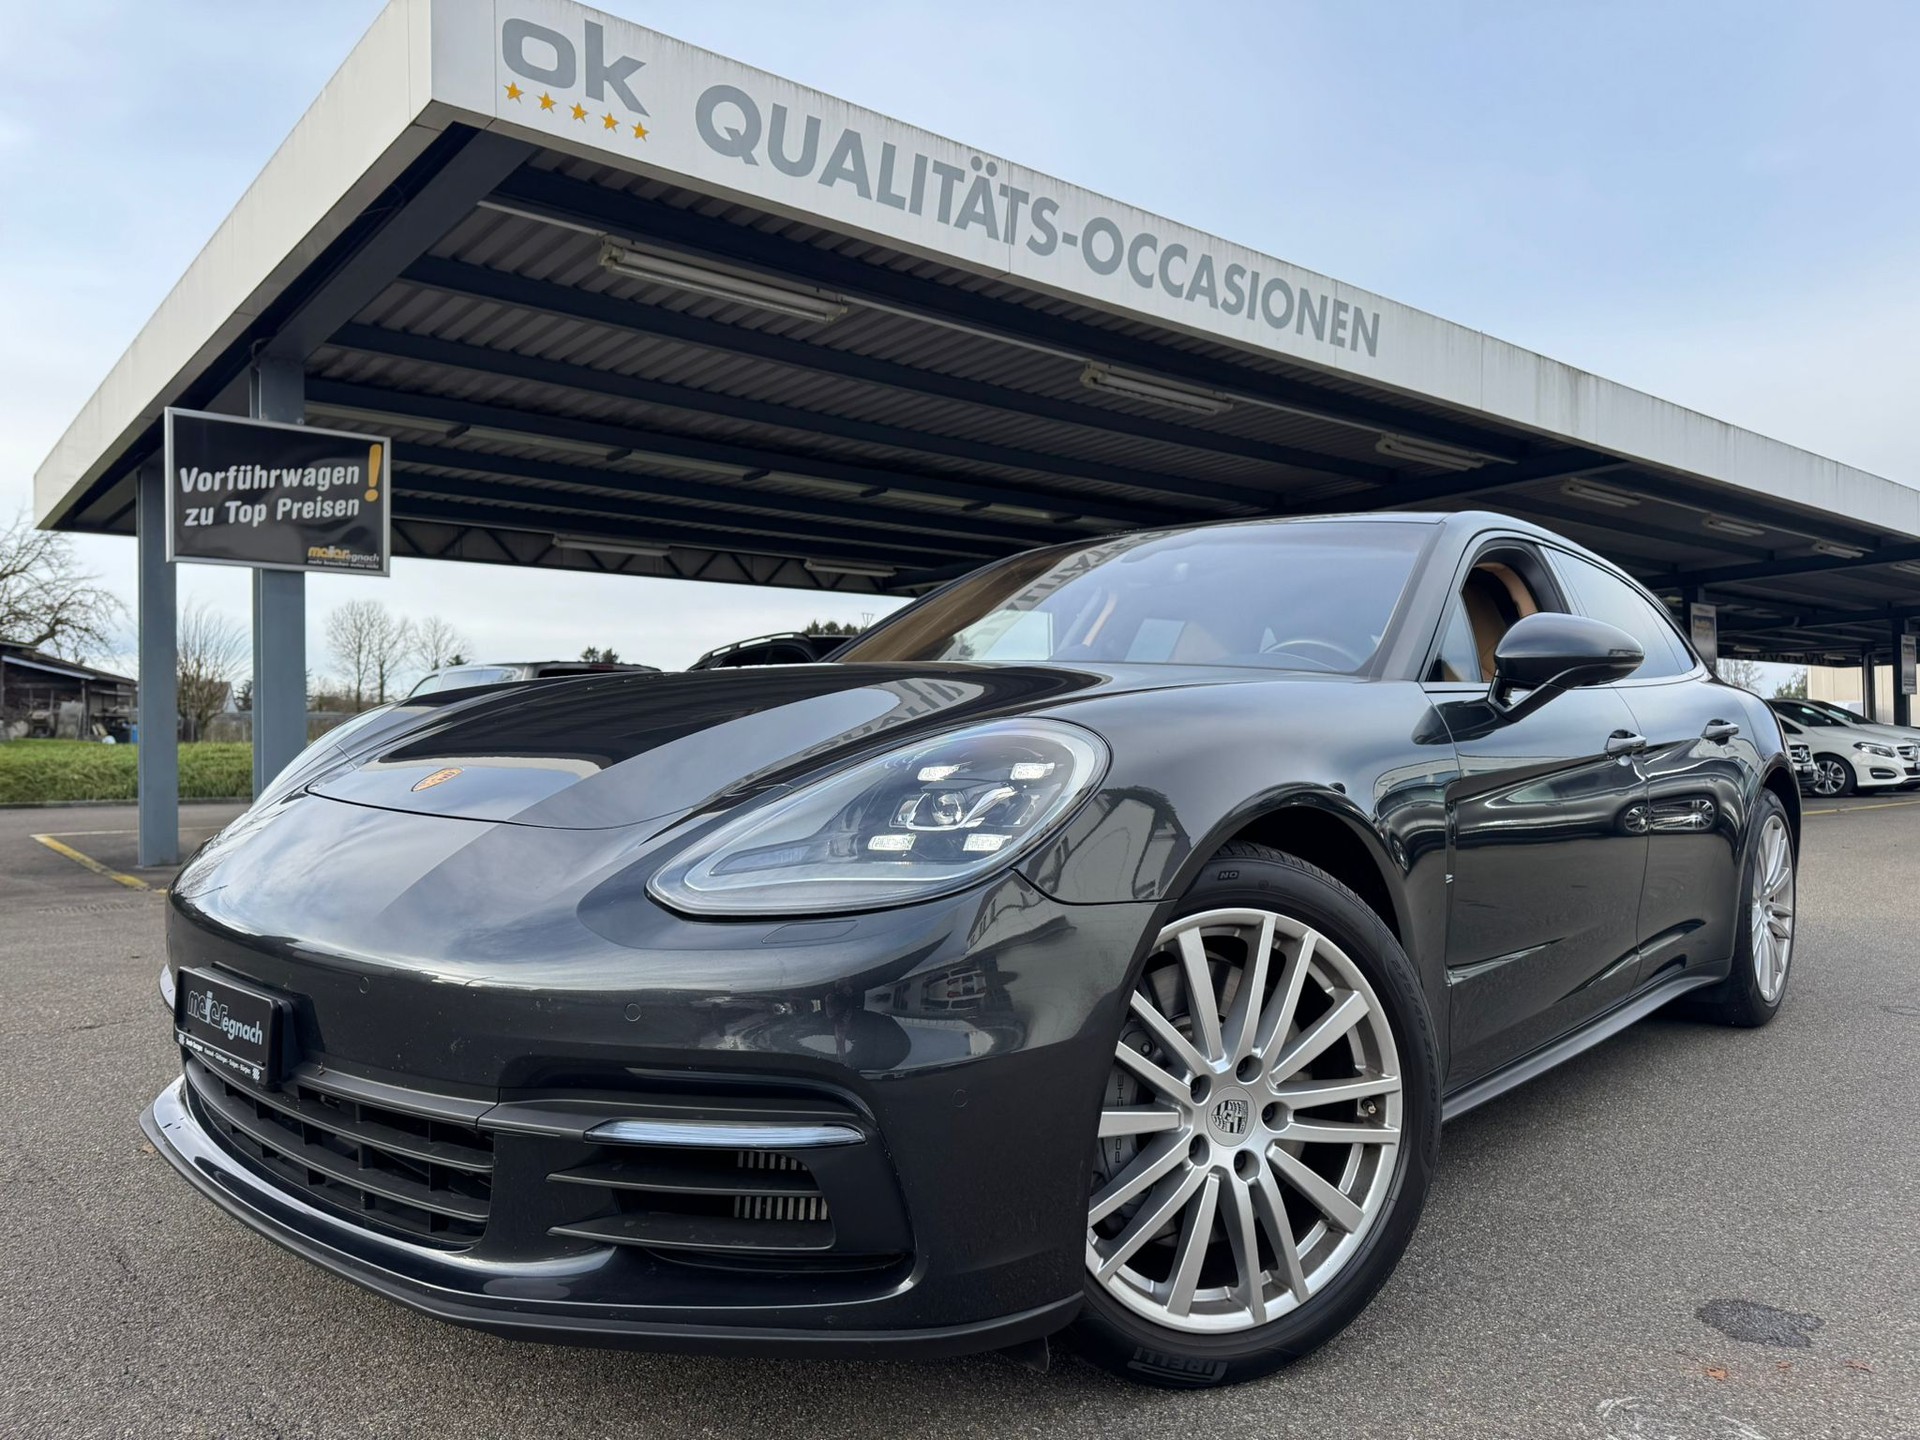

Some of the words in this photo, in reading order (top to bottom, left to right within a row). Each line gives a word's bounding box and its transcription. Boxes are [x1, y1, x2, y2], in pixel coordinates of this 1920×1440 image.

[502, 17, 649, 117] ok
[695, 84, 1380, 357] QUALITÄTS-OCCASIONEN
[180, 465, 359, 493] Vorführwagen
[184, 507, 214, 527] zu
[225, 500, 267, 527] Top
[276, 496, 360, 520] Preisen
